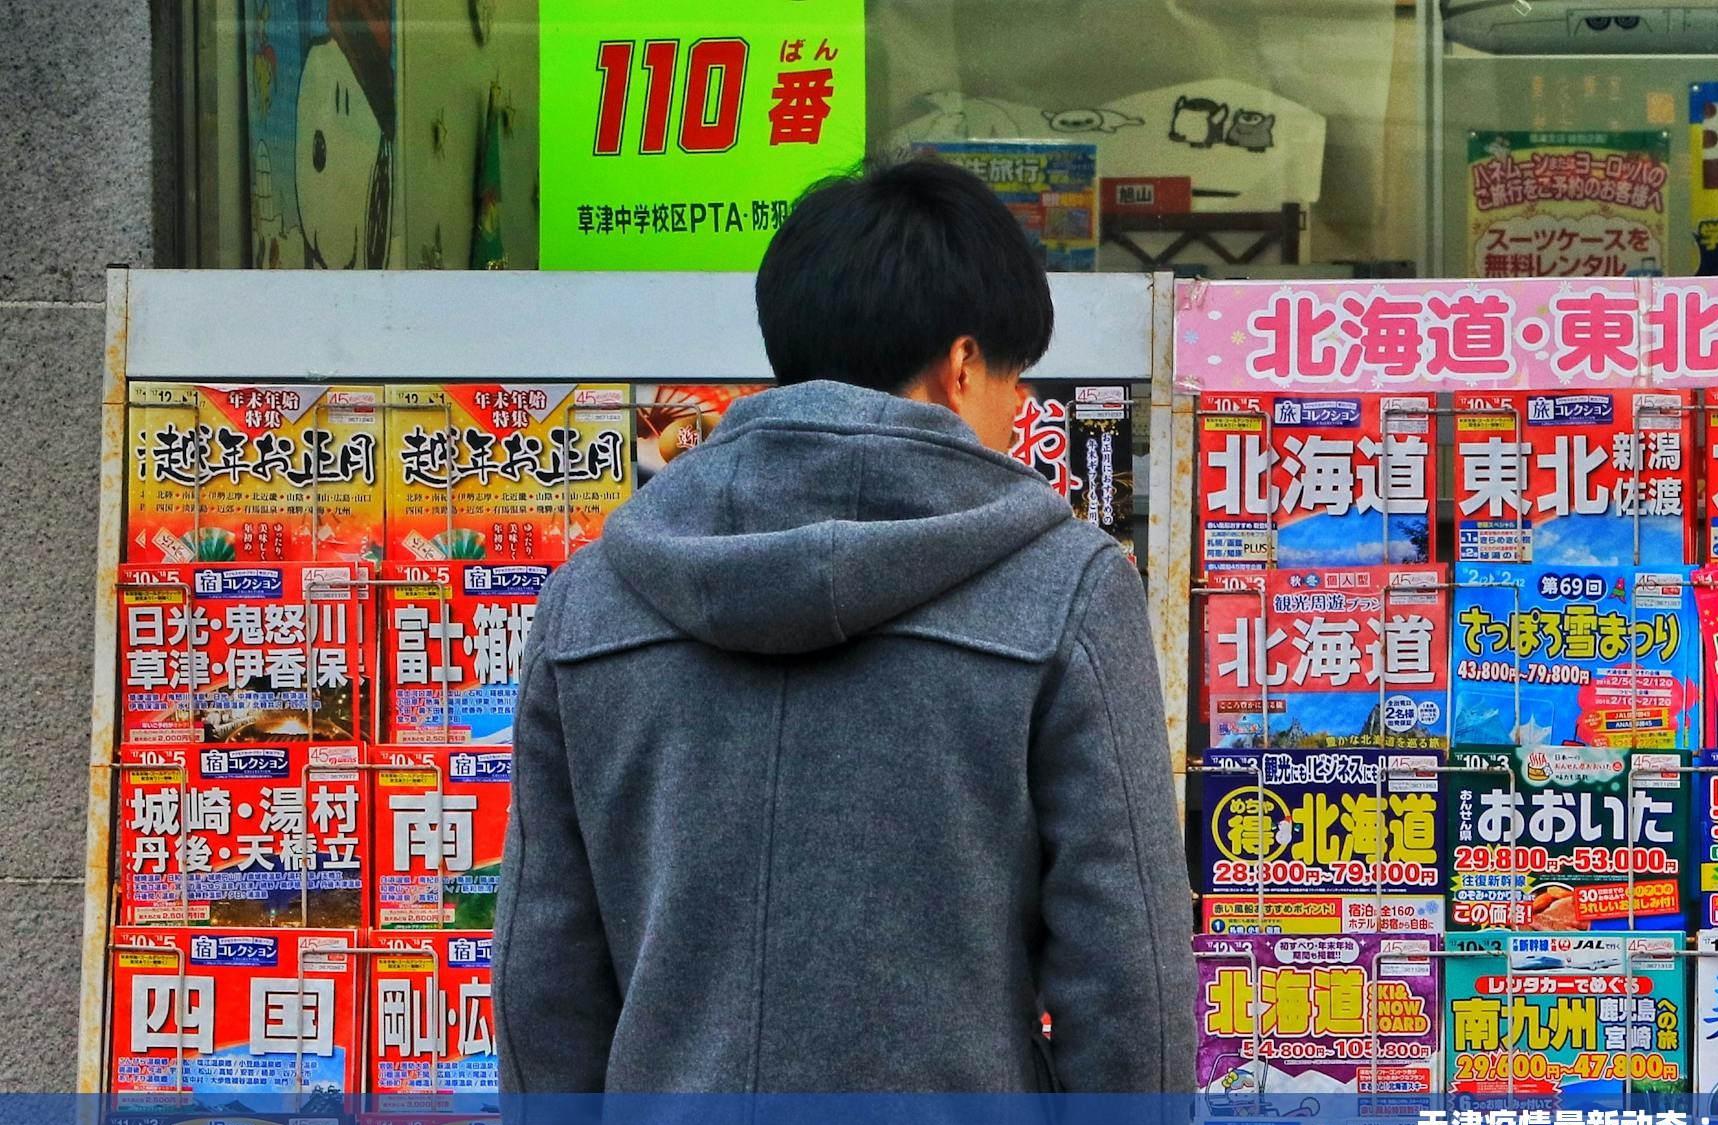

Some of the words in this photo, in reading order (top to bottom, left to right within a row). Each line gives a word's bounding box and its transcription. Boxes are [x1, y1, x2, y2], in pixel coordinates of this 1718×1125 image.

[780, 39, 838, 61] ばん
[593, 37, 834, 156] 110番
[1484, 254, 1627, 277] 無料レンタル
[1487, 227, 1650, 252] スーツケースを
[229, 392, 300, 410] 年末年始
[245, 410, 281, 429] 特集
[152, 425, 376, 486] 越年お正月
[400, 429, 624, 487] 越年お正月
[1102, 432, 1113, 525] お正月におすすめの
[1206, 435, 1429, 517] 北海道
[1458, 435, 1611, 518] 東北
[222, 576, 282, 594] コレクション
[1541, 576, 1603, 597] 第69回
[127, 604, 347, 647] 日光・鬼怒川
[1216, 614, 1438, 687] 北海道
[1458, 608, 1681, 661] さっぽろ雪まつり
[126, 648, 348, 691] 草津・伊香保
[129, 785, 360, 835] 城崎・湯村
[1291, 794, 1439, 865] 北海道
[1458, 789, 1474, 842] おんせん県
[1477, 788, 1675, 845] おおいた
[130, 834, 361, 873] 丹後・天橋立
[131, 975, 335, 1057] 四国
[1206, 967, 1368, 1037] 北海道
[1453, 996, 1598, 1052] 南九州
